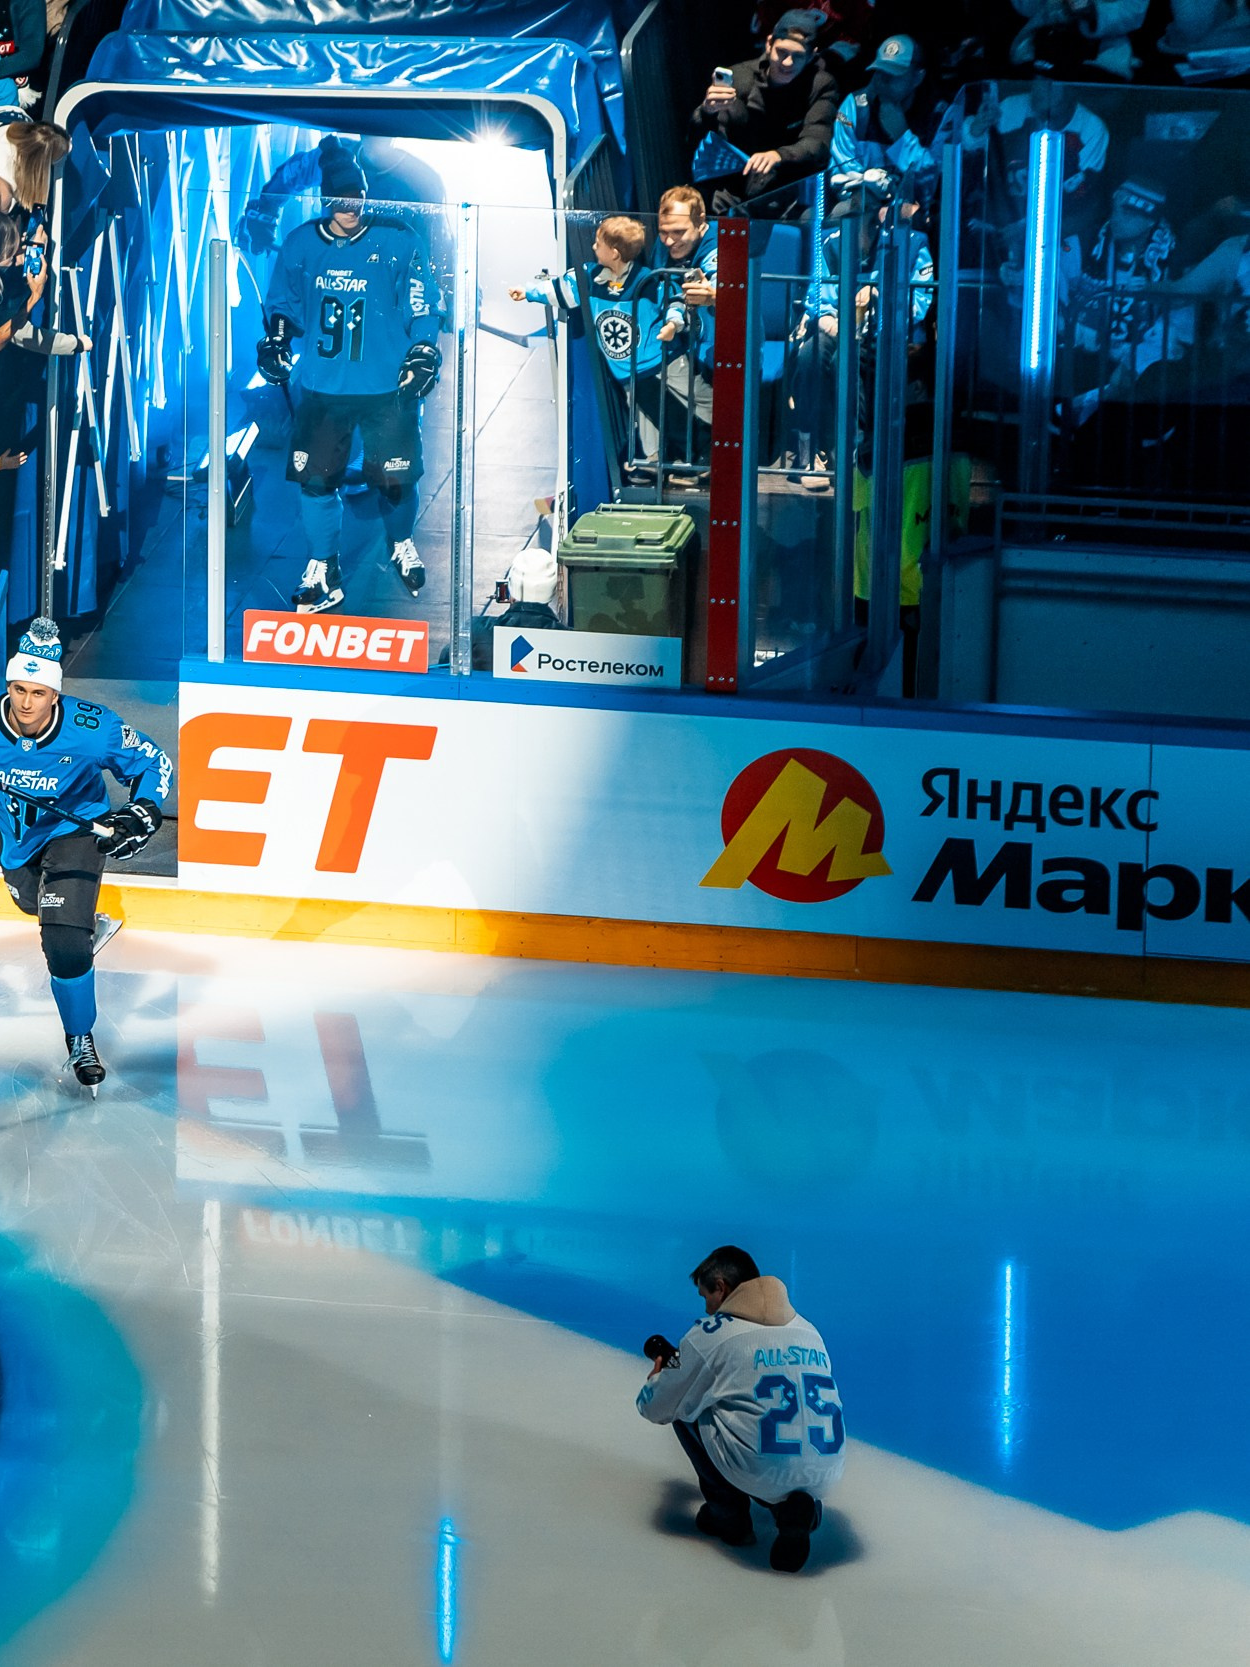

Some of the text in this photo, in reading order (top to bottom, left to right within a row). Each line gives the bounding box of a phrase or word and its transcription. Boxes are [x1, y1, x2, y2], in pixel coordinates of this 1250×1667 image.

[317, 294, 367, 362] 91
[246, 619, 425, 663] FONBET
[537, 653, 664, 677] Ростелеком
[73, 701, 103, 731] 89
[10, 767, 43, 777] FONBET
[130, 804, 156, 834] CM
[919, 767, 1159, 832] Яндекс
[911, 837, 1250, 931] Марк
[754, 1373, 846, 1456] 25
